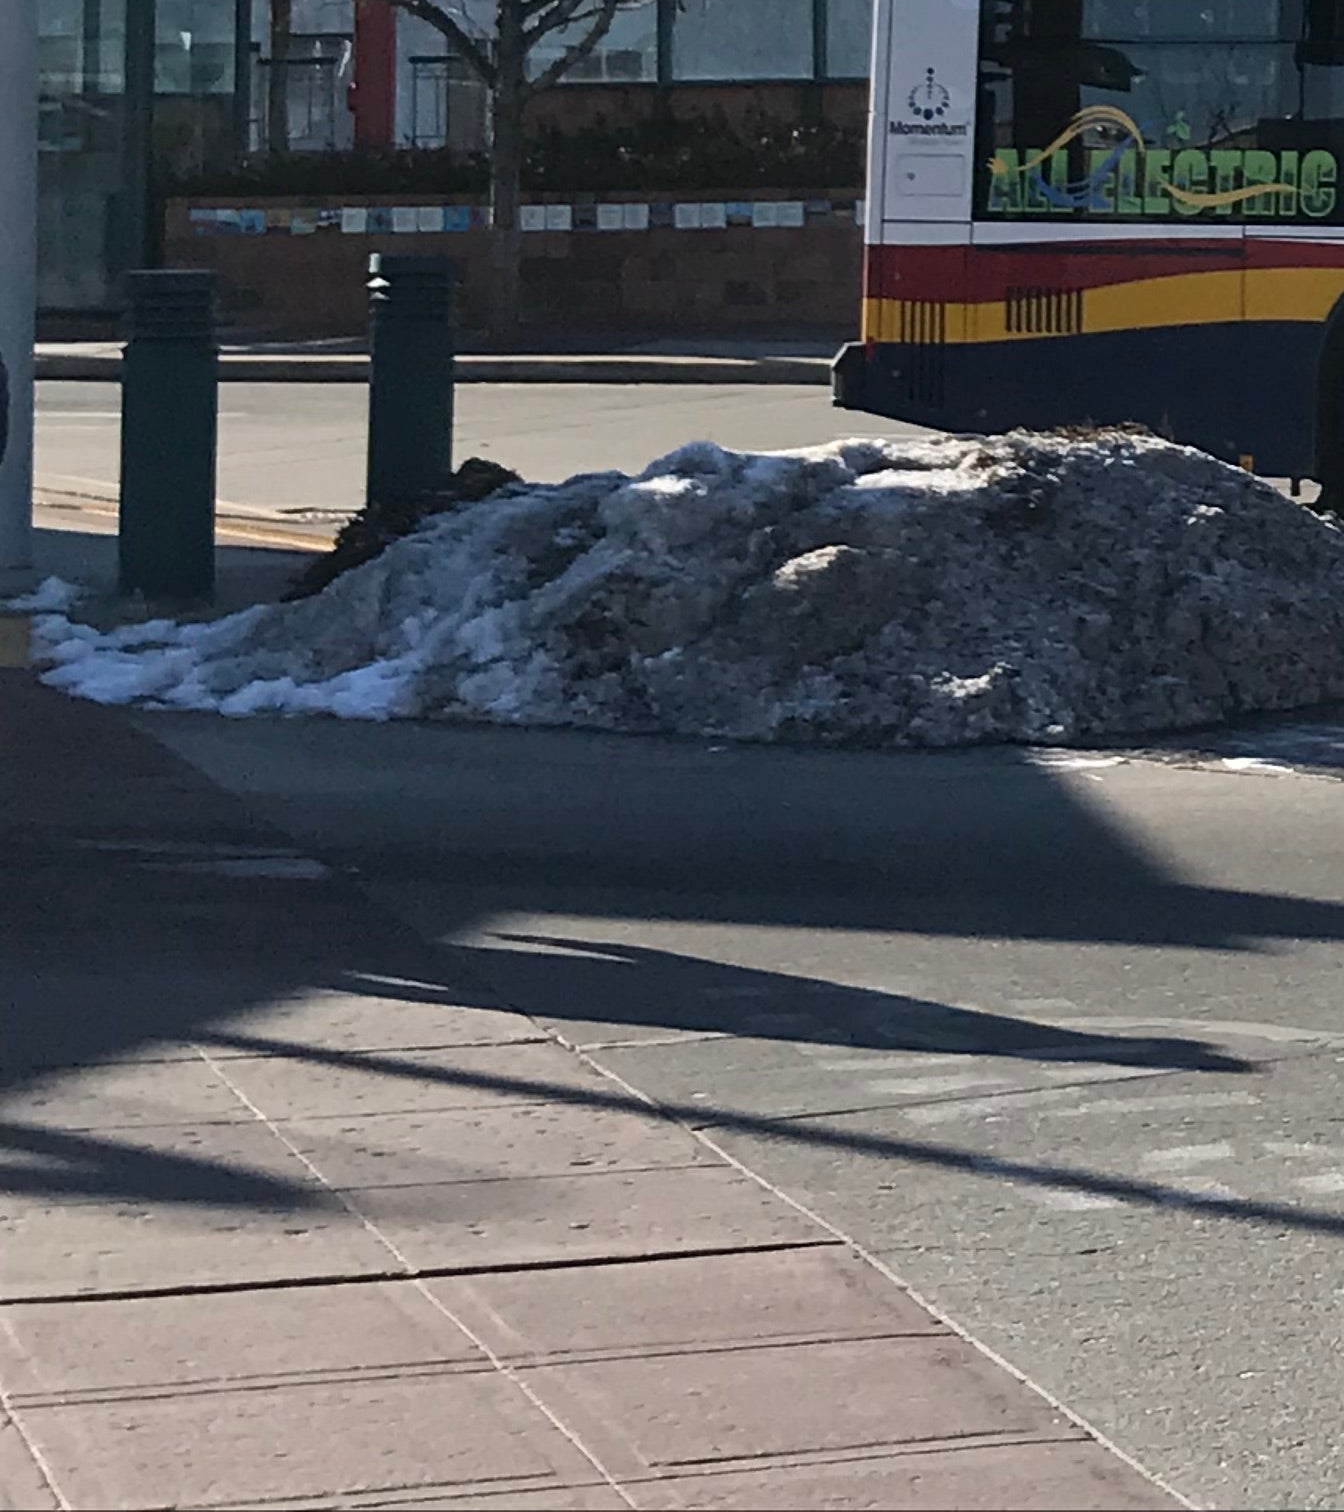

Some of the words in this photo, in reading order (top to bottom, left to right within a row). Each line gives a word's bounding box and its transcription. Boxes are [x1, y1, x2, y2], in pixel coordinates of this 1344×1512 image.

[889, 121, 967, 136] Momentum
[987, 148, 1074, 213] ALL
[1088, 148, 1338, 218] ELECTRIC
